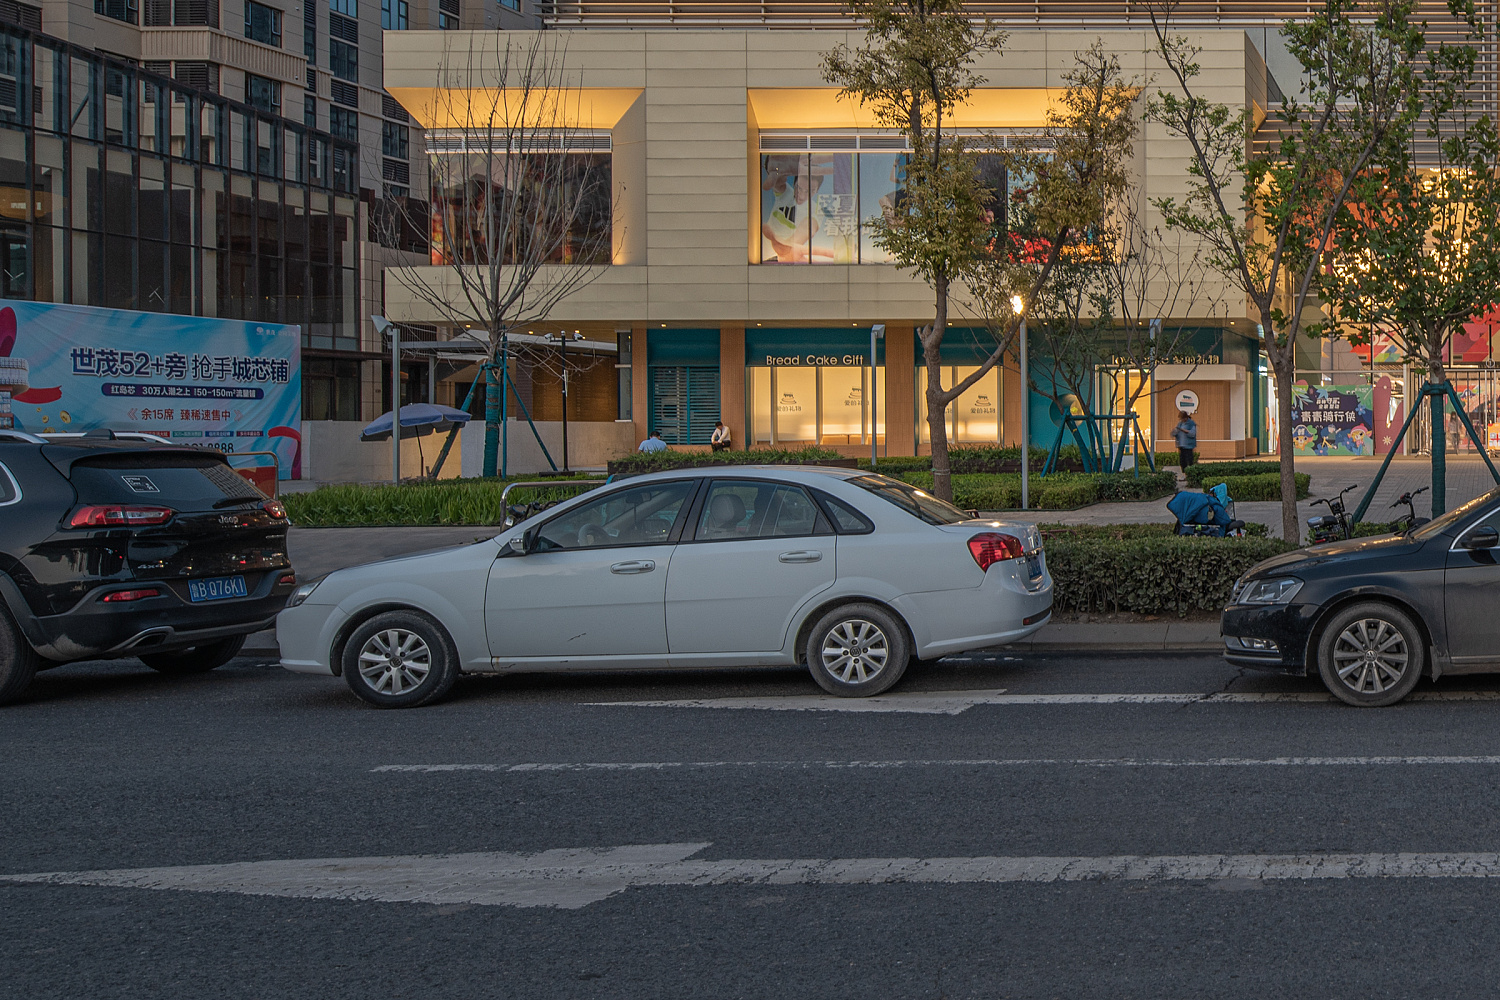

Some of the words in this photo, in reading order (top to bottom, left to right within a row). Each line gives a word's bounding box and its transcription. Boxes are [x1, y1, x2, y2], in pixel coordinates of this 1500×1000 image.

[70, 347, 187, 378] 世茂52+旁
[191, 354, 290, 383] 抢手城芯铺
[766, 355, 800, 366] Bread
[806, 355, 838, 366] Cake
[842, 355, 864, 366] Gift
